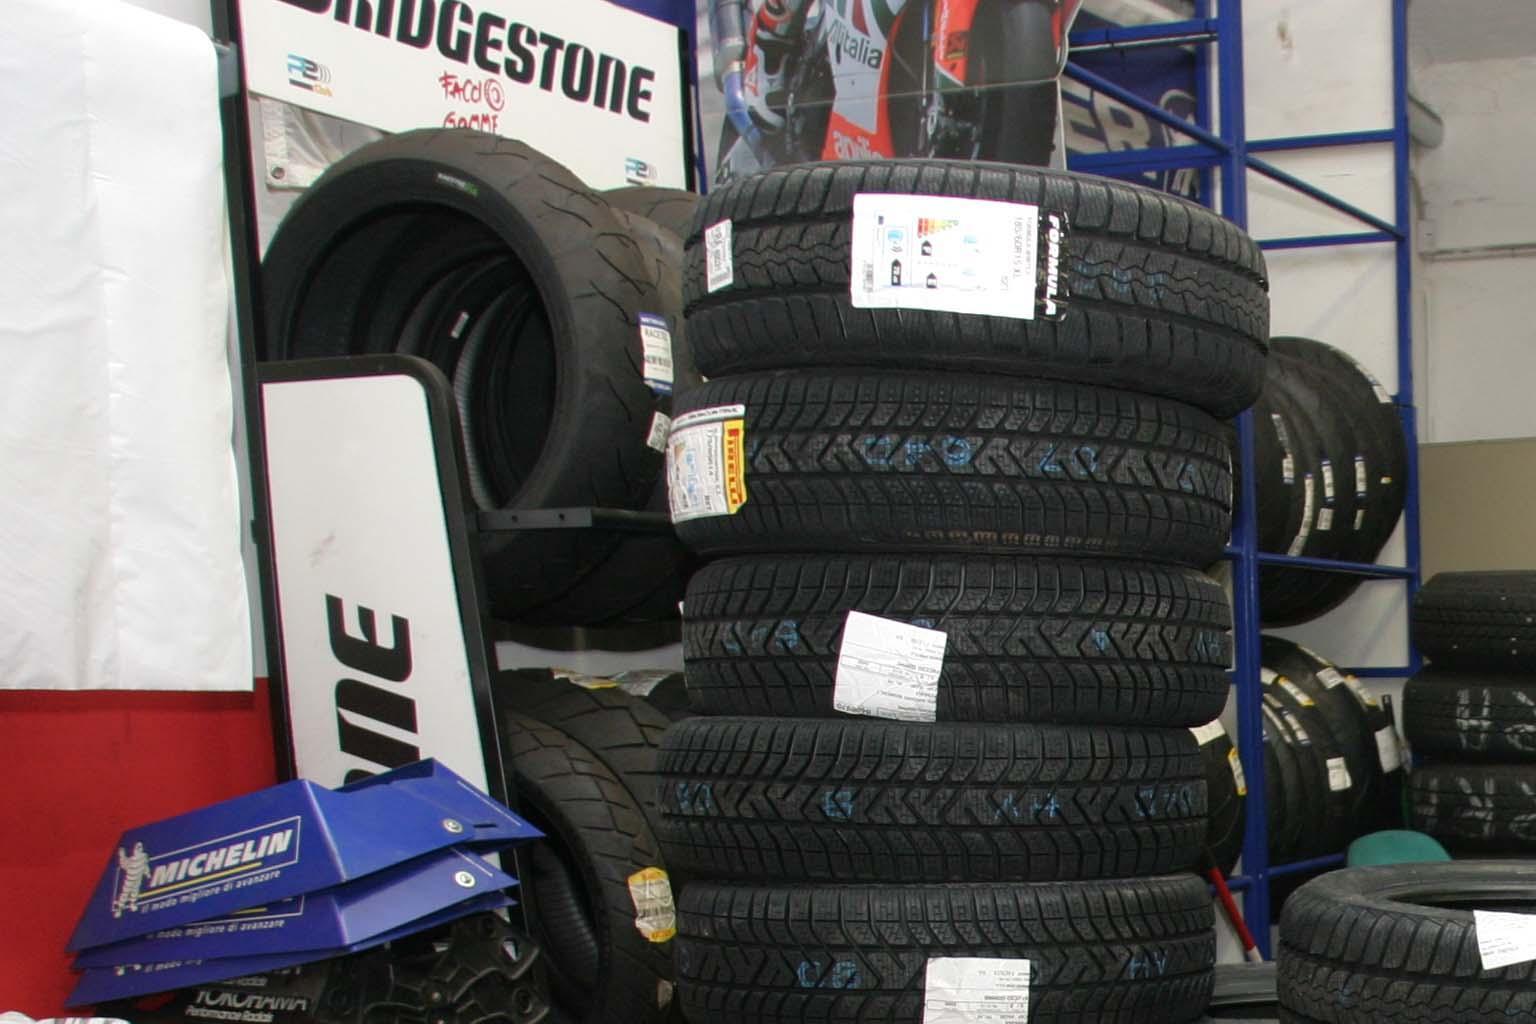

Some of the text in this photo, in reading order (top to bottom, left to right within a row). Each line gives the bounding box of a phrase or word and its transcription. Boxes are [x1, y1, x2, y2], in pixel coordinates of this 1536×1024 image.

[274, 0, 655, 123] RIDGESTONE
[1045, 213, 1061, 316] FORMULA
[150, 829, 293, 888] MICHELIN
[179, 886, 221, 904] migliore
[235, 869, 281, 889] avanzare
[185, 924, 225, 938] migliore
[240, 919, 285, 932] avanzare
